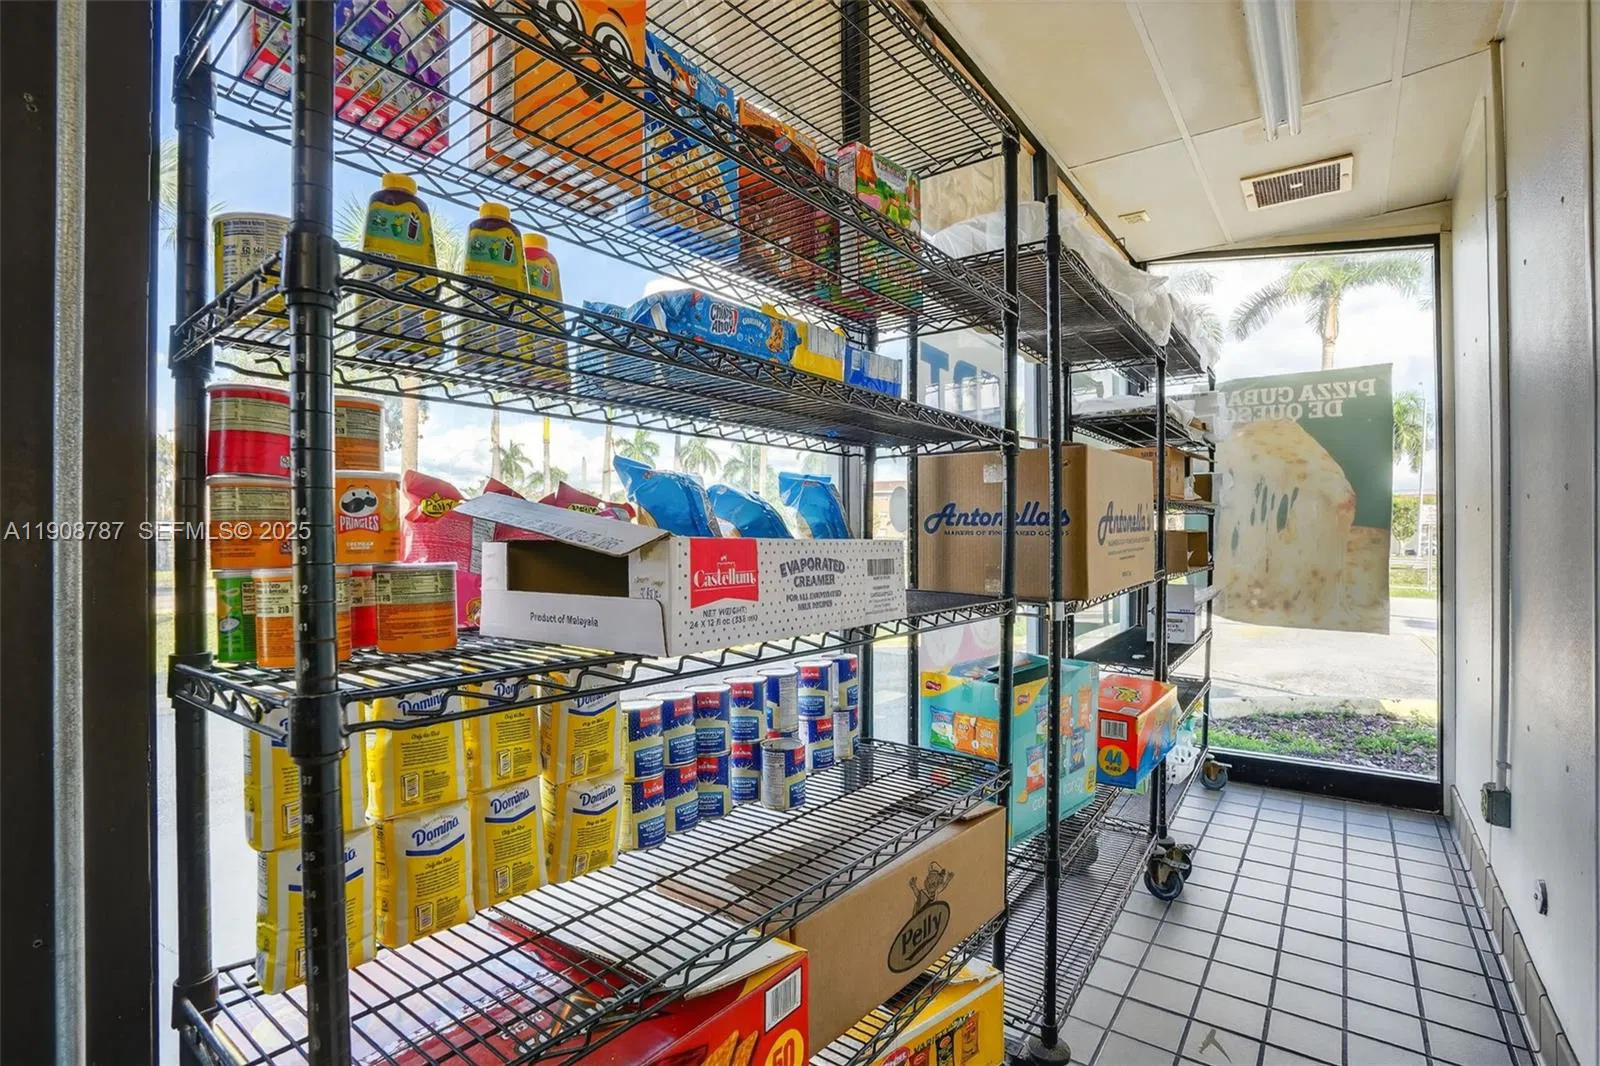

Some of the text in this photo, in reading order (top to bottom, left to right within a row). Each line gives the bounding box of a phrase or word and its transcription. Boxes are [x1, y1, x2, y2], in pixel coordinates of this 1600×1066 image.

[339, 515, 380, 532] PRINGLES
[693, 567, 757, 589] Castellum
[779, 557, 845, 578] EVAPORATED
[793, 574, 836, 588] CREAMER
[530, 612, 557, 624] Product
[558, 614, 565, 624] of
[703, 609, 717, 618] NET
[1105, 749, 1123, 765] 44
[490, 787, 531, 815] Domino
[580, 783, 617, 807] Domino
[411, 815, 460, 848] Domino
[901, 911, 943, 955] Pelly
